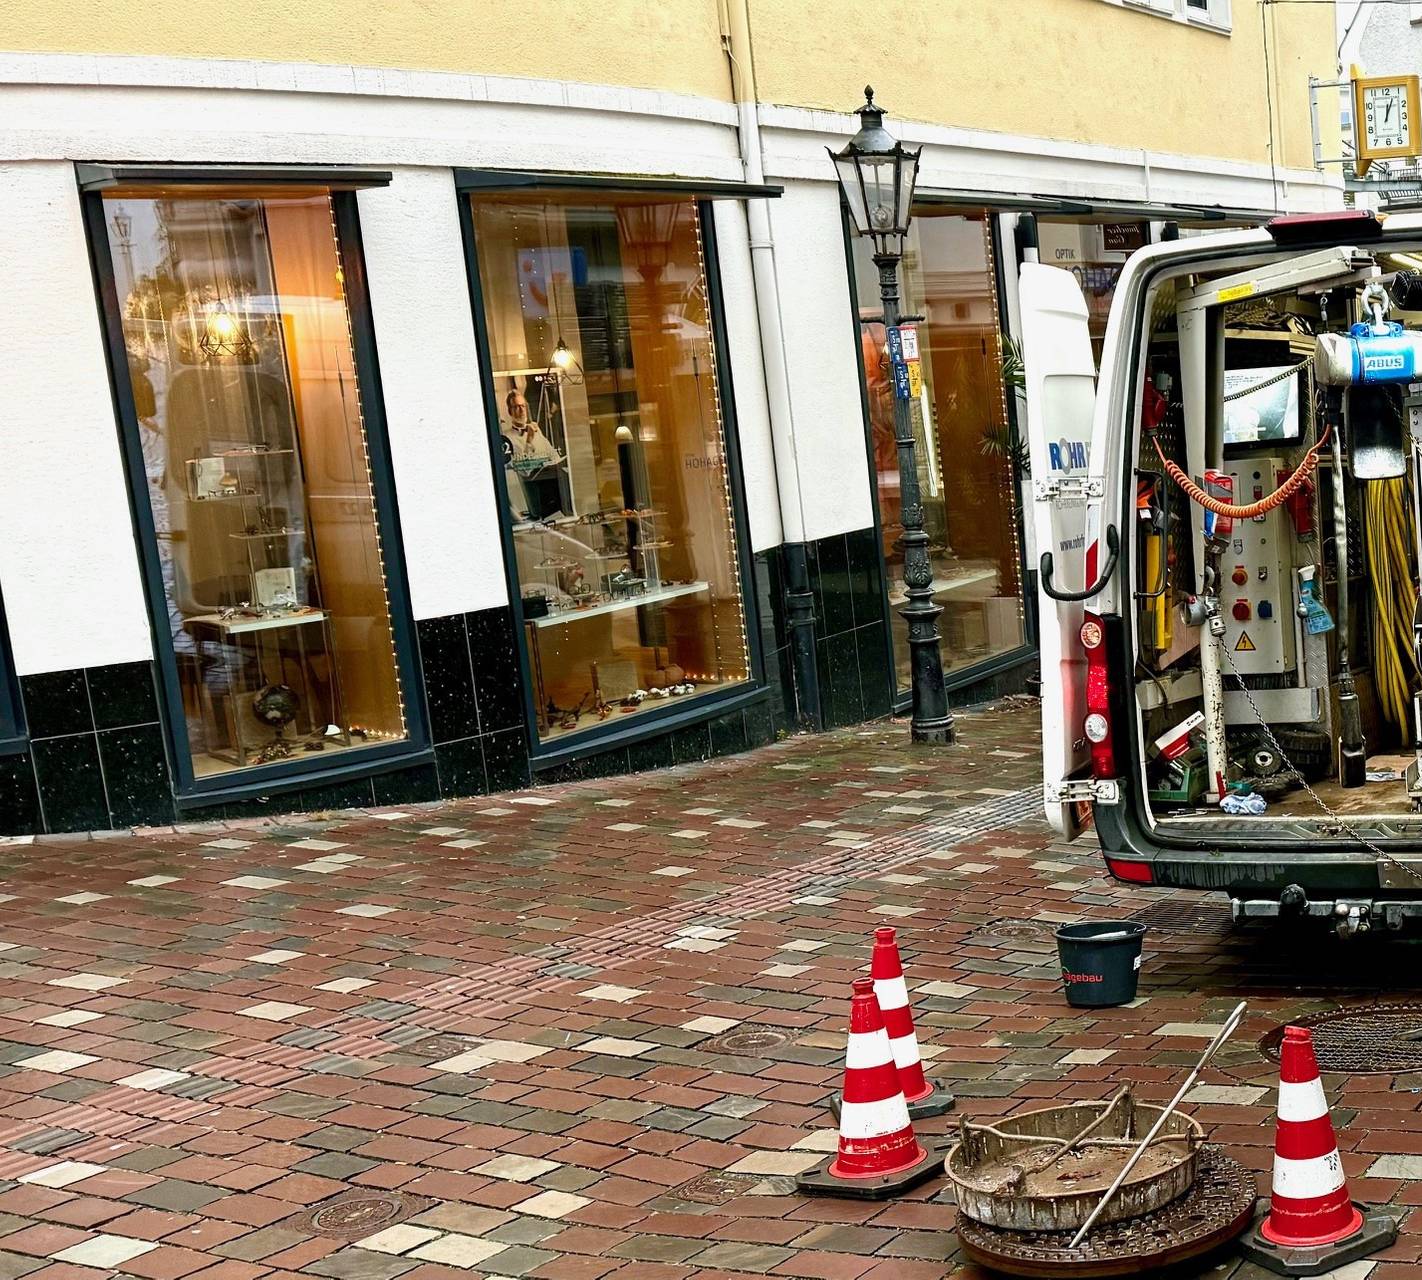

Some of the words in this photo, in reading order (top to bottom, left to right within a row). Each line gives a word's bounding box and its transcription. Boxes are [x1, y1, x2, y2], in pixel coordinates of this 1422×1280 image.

[1382, 88, 1390, 96] 12
[1366, 102, 1373, 110] 10
[1368, 114, 1372, 122] 9
[1402, 112, 1407, 120] 3
[1368, 126, 1373, 134] 8
[1386, 138, 1391, 146] 6
[1055, 249, 1075, 259] OPTIK
[1366, 358, 1403, 369] ABUS
